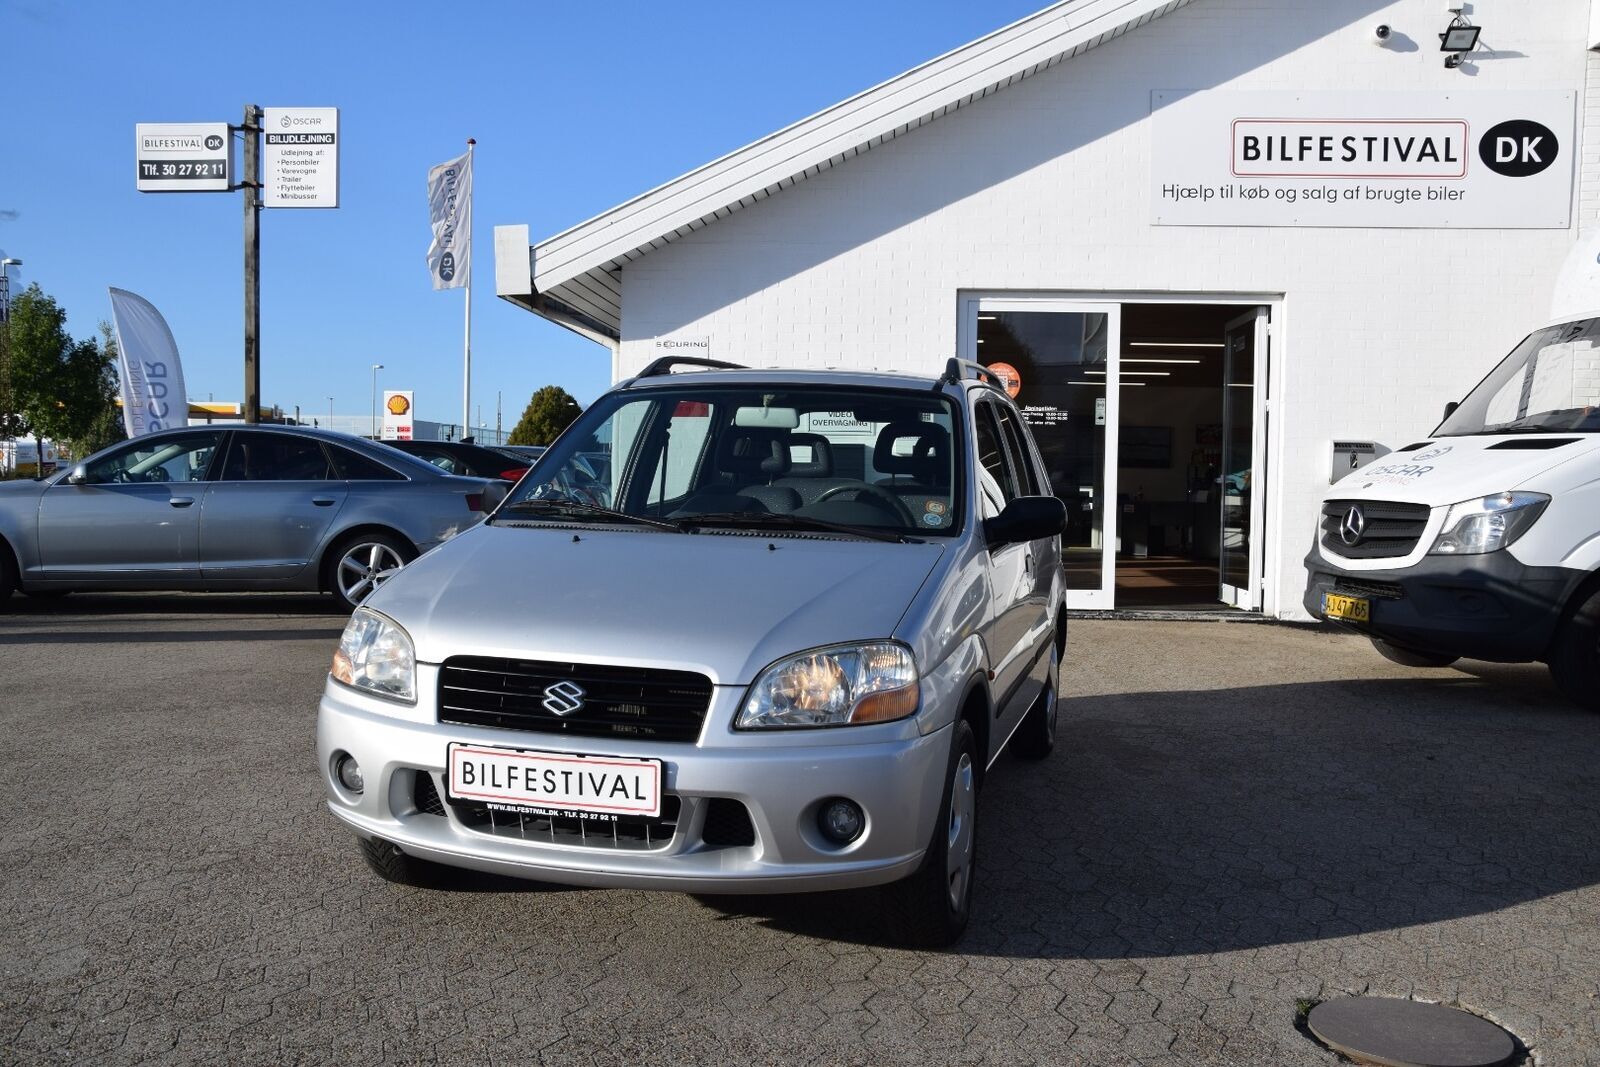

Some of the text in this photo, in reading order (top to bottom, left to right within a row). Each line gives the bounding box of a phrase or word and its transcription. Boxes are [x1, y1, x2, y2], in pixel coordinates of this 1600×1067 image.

[144, 139, 220, 148] BILFESTIVAL DK
[269, 135, 332, 143] BILUDLEJNING
[1242, 135, 1543, 164] BILFESTIVAL DK
[142, 163, 223, 175] Tlf. 30 27 92 11
[1162, 184, 1466, 204] Hjælp til køb og salg af brugte biler
[442, 258, 453, 276] DK
[462, 761, 647, 800] BILFESTIVAL
[486, 803, 559, 817] WWW.BILFESTIVAL.DK
[564, 810, 578, 818] TLF.
